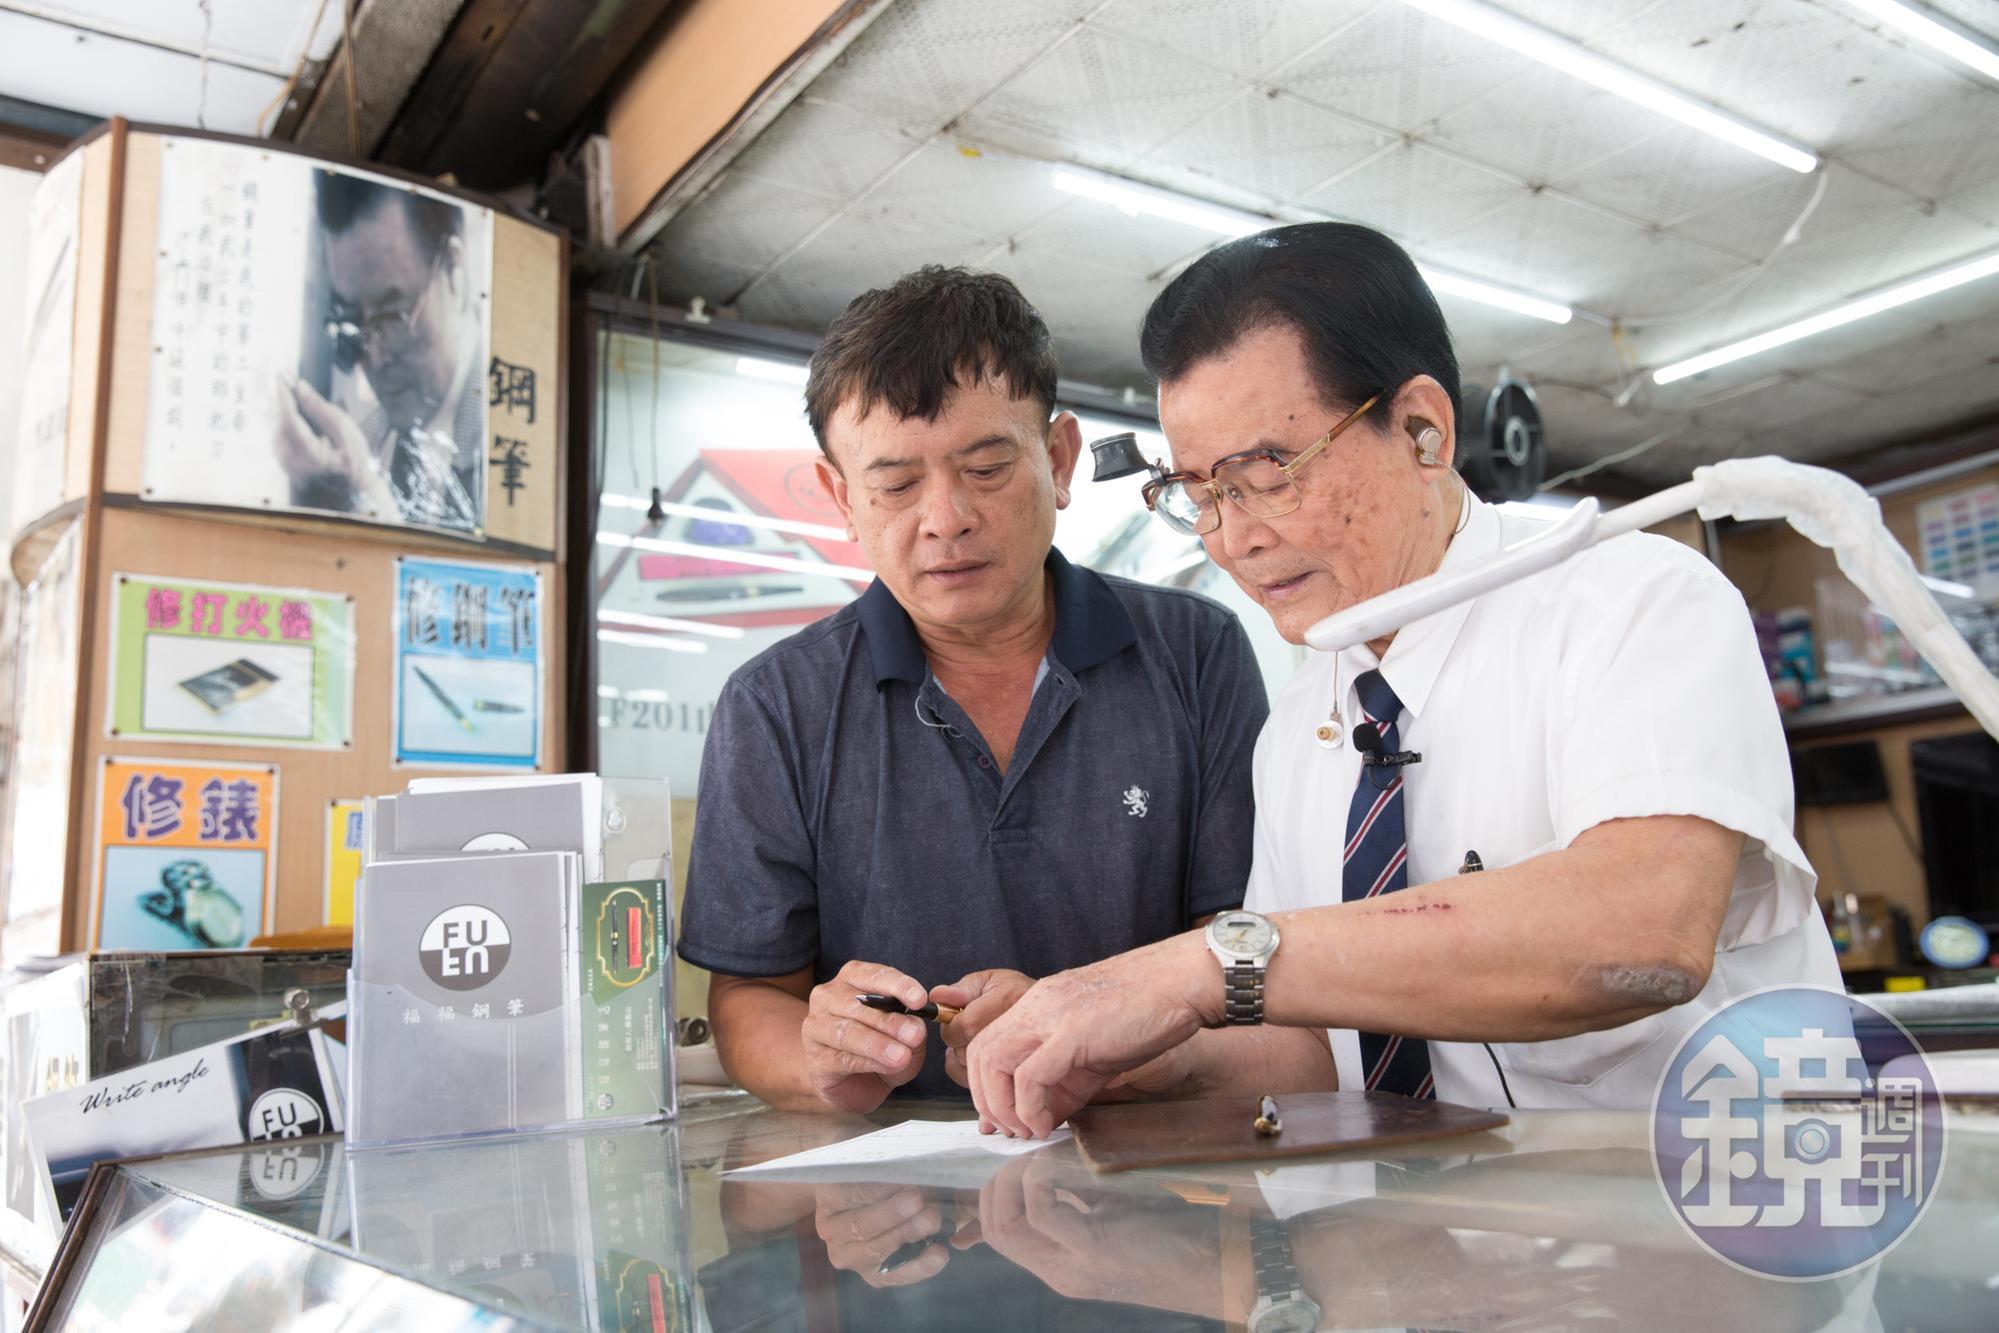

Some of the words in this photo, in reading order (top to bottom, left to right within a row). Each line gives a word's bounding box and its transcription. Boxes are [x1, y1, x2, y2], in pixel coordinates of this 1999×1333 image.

[145, 586, 313, 641] 修打火機
[122, 774, 260, 842] 修錶
[442, 919, 488, 949] FU
[79, 1080, 148, 1115] Write
[150, 1058, 211, 1094] angle
[262, 1102, 298, 1132] FU
